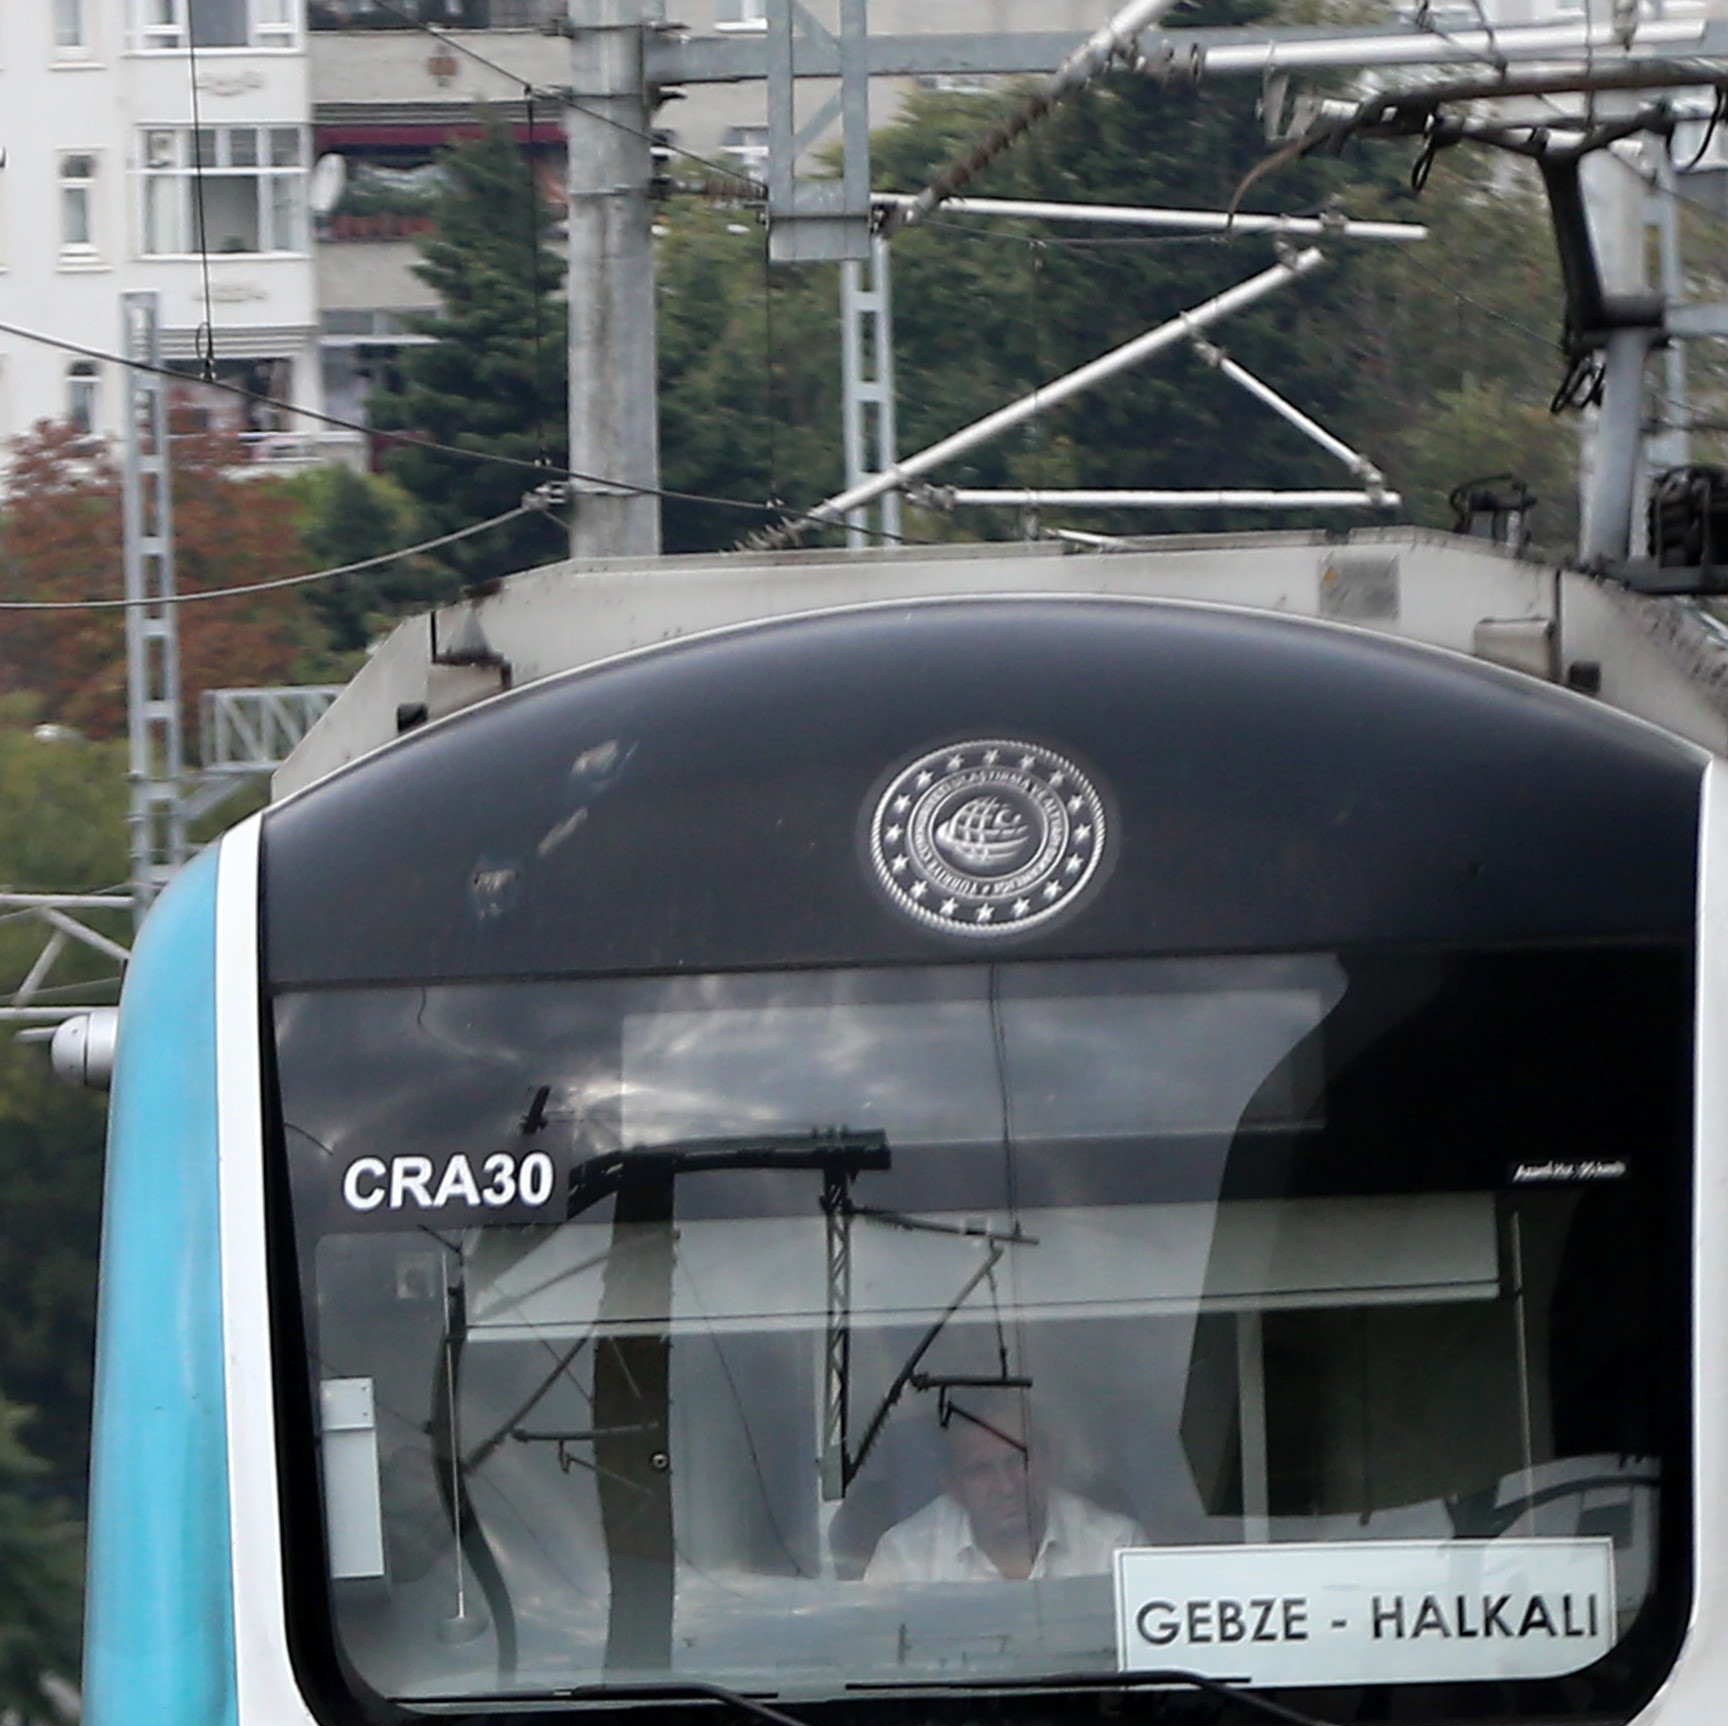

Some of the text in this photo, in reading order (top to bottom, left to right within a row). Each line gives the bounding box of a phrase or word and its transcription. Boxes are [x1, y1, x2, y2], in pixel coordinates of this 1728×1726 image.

[344, 1153, 554, 1210] CRA30
[1136, 1594, 1600, 1646] GEBZE - HALKALI
